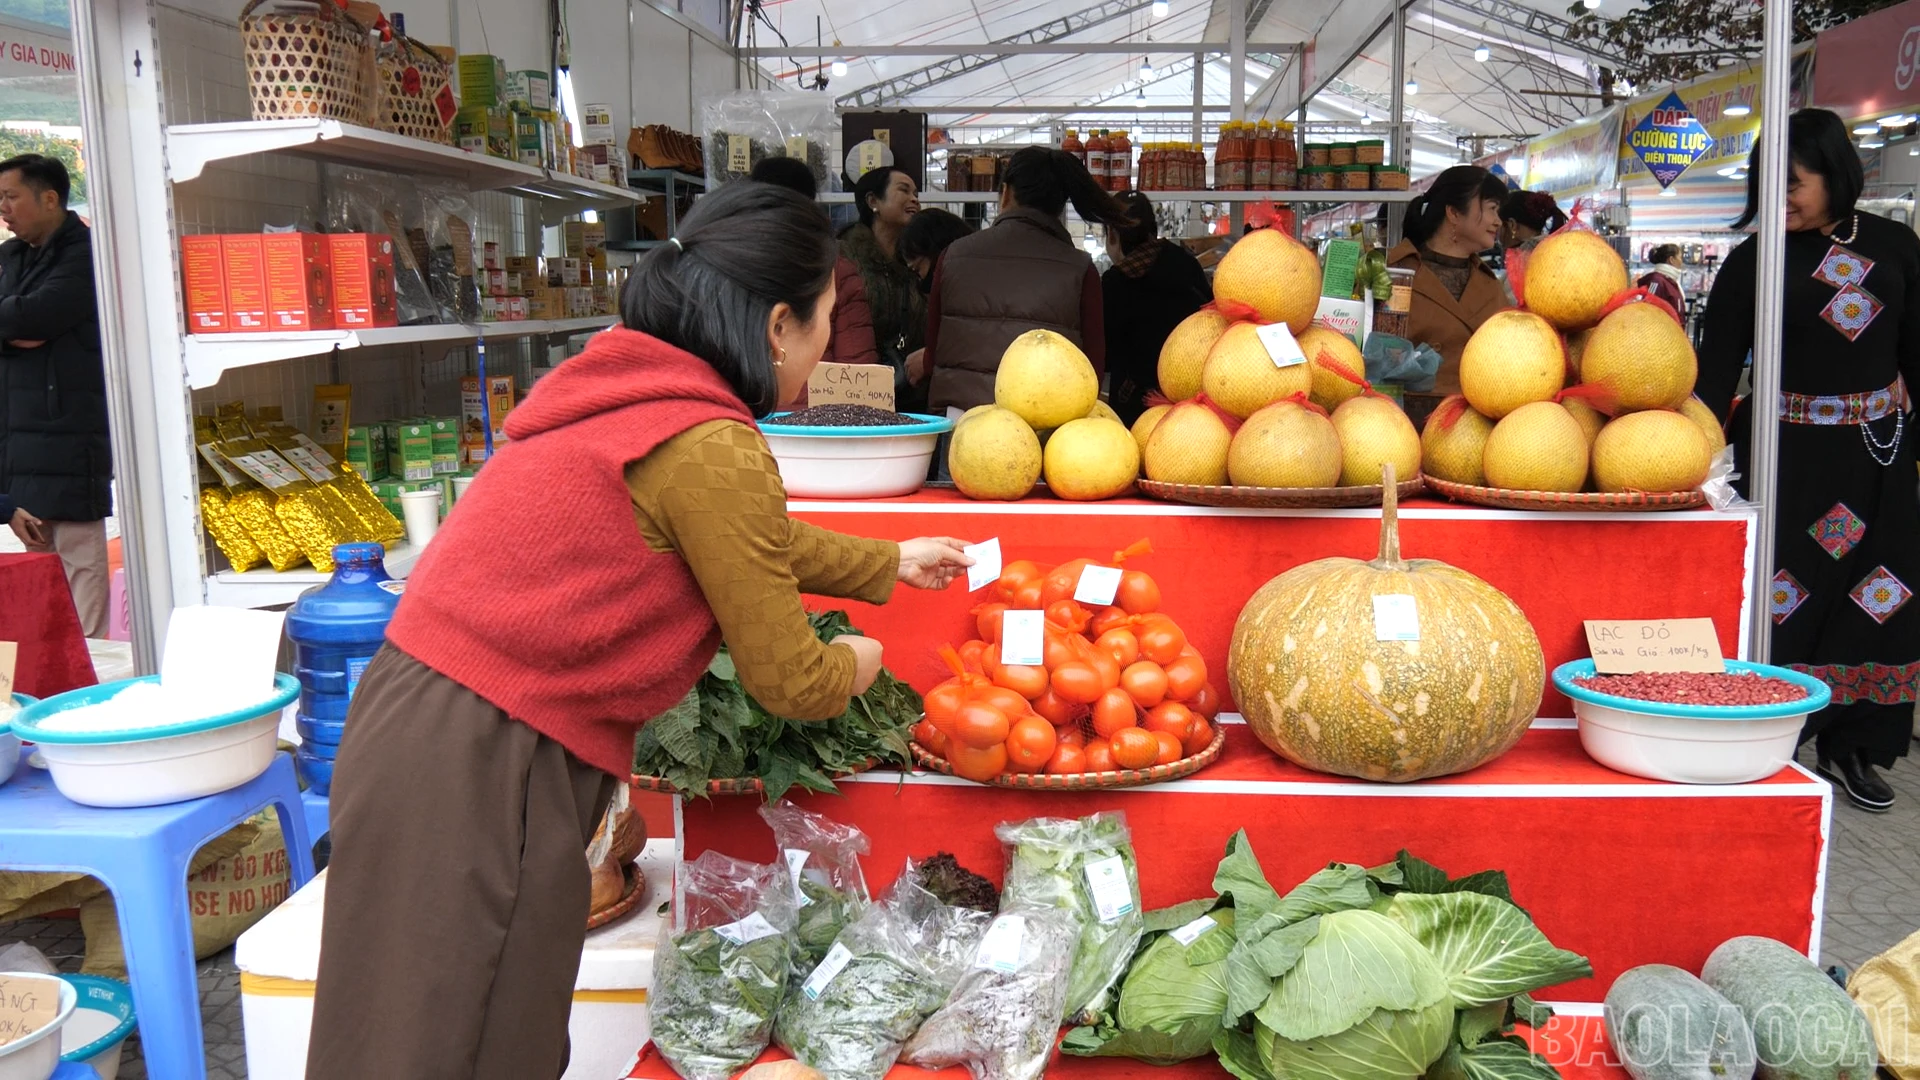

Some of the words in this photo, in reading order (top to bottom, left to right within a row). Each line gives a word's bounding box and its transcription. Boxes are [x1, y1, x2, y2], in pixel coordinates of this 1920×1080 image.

[11, 43, 37, 65] GIA
[1652, 106, 1689, 127] DÁN
[1632, 128, 1677, 149] CƯỜNG
[1681, 131, 1706, 153] LỰC
[1644, 150, 1665, 166] ĐIỆN
[1667, 153, 1692, 167] THOẠI
[1641, 622, 1670, 640] ĐỎ
[233, 855, 257, 881] 80
[229, 889, 256, 915] NO
